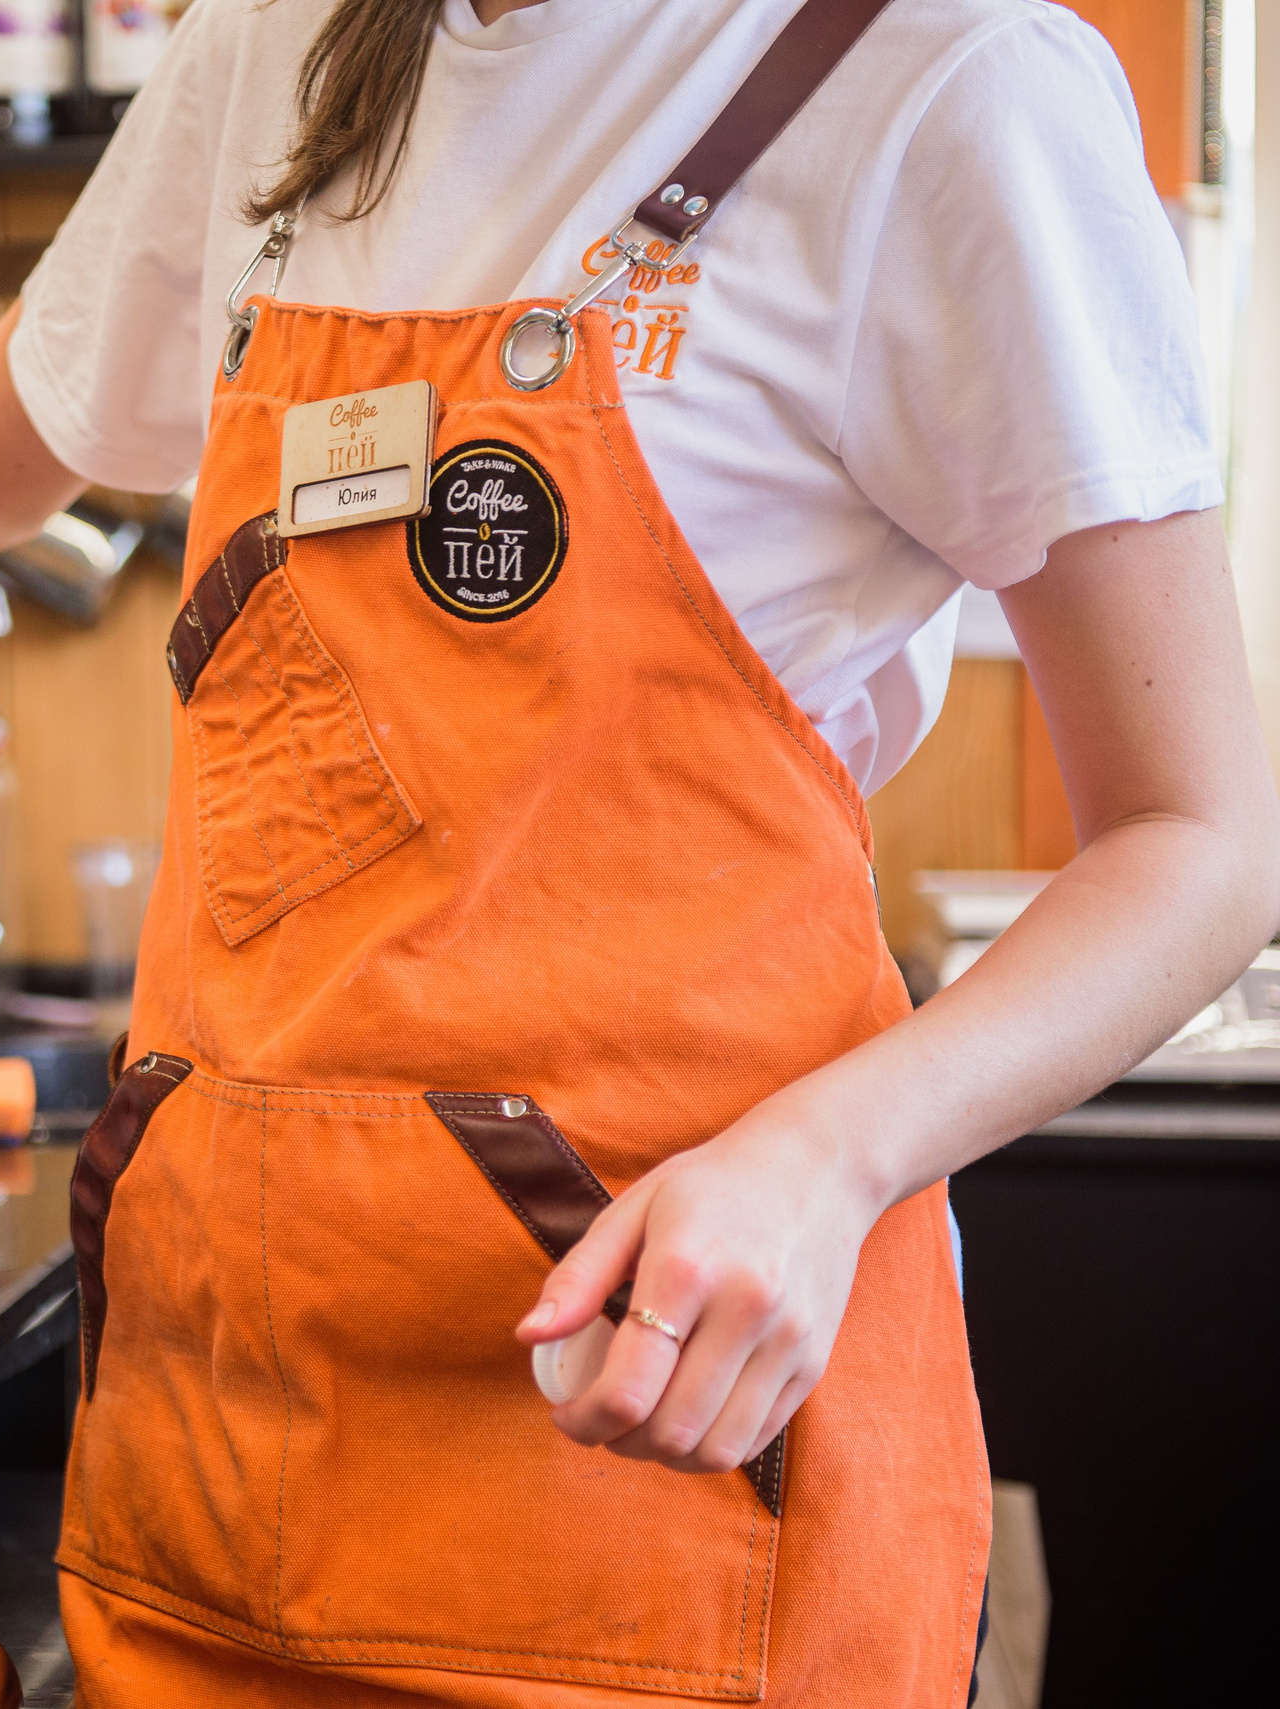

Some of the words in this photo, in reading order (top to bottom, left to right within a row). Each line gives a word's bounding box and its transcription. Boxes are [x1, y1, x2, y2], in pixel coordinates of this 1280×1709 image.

[581, 234, 701, 294] Cffee
[612, 312, 687, 381] ей
[329, 398, 379, 429] Coffee
[327, 435, 377, 475] пей
[337, 487, 378, 506] Юлия
[446, 479, 529, 521] Coffee
[443, 533, 525, 582] пей
